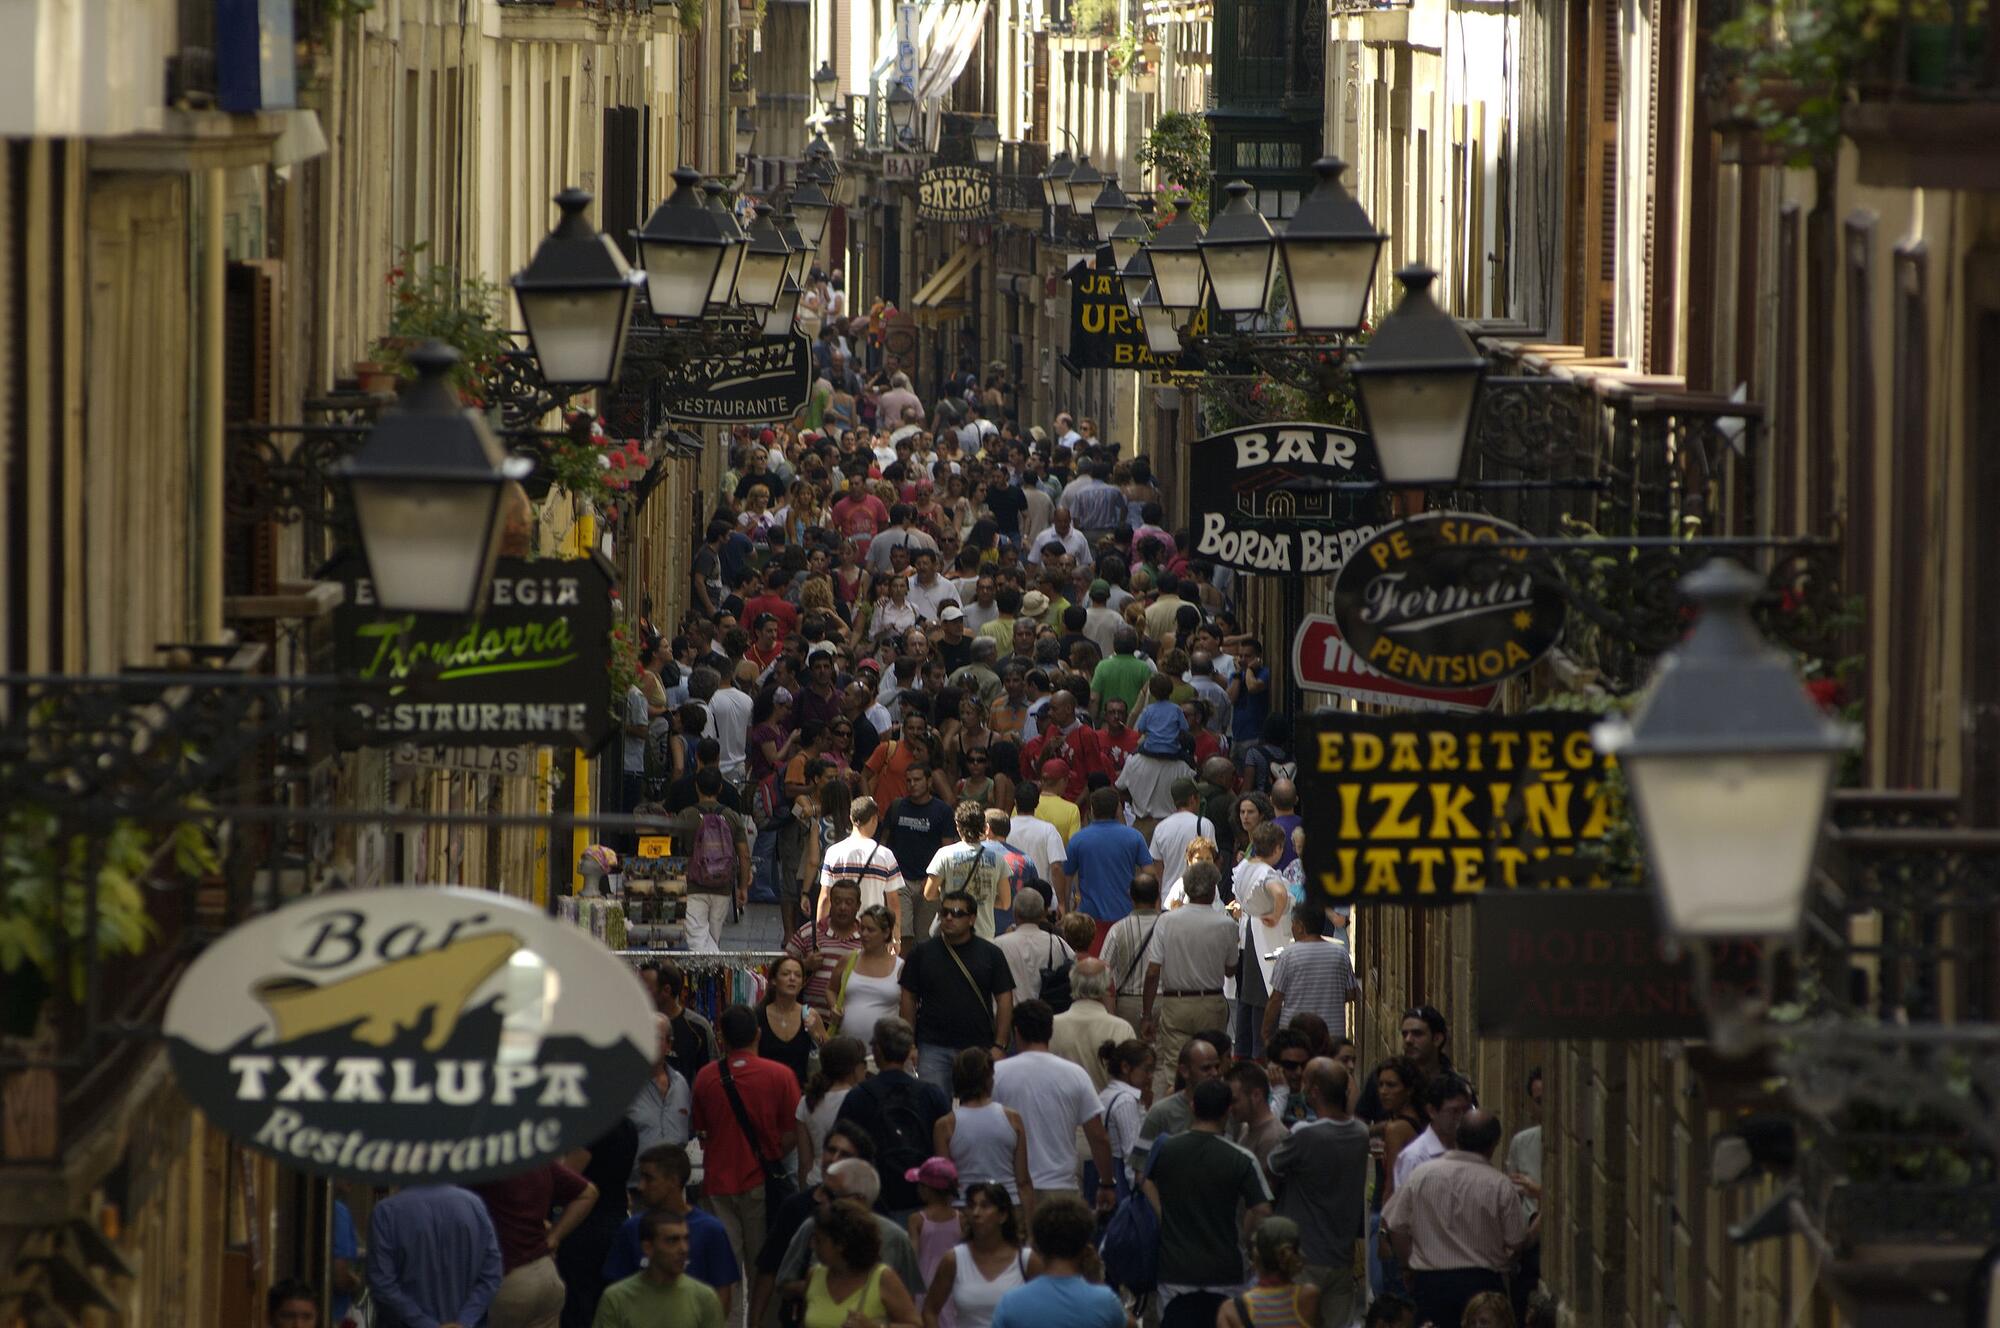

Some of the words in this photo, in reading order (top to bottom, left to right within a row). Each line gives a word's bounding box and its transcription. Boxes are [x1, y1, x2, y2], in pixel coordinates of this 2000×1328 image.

[919, 166, 992, 184] JATETXE
[1233, 429, 1357, 470] BAR
[1197, 512, 1291, 572] BORDA
[1369, 637, 1530, 683] PENTSIOA
[283, 909, 491, 968] Bar
[229, 1055, 589, 1107] TXALUPA
[254, 1106, 563, 1175] Restaurante
